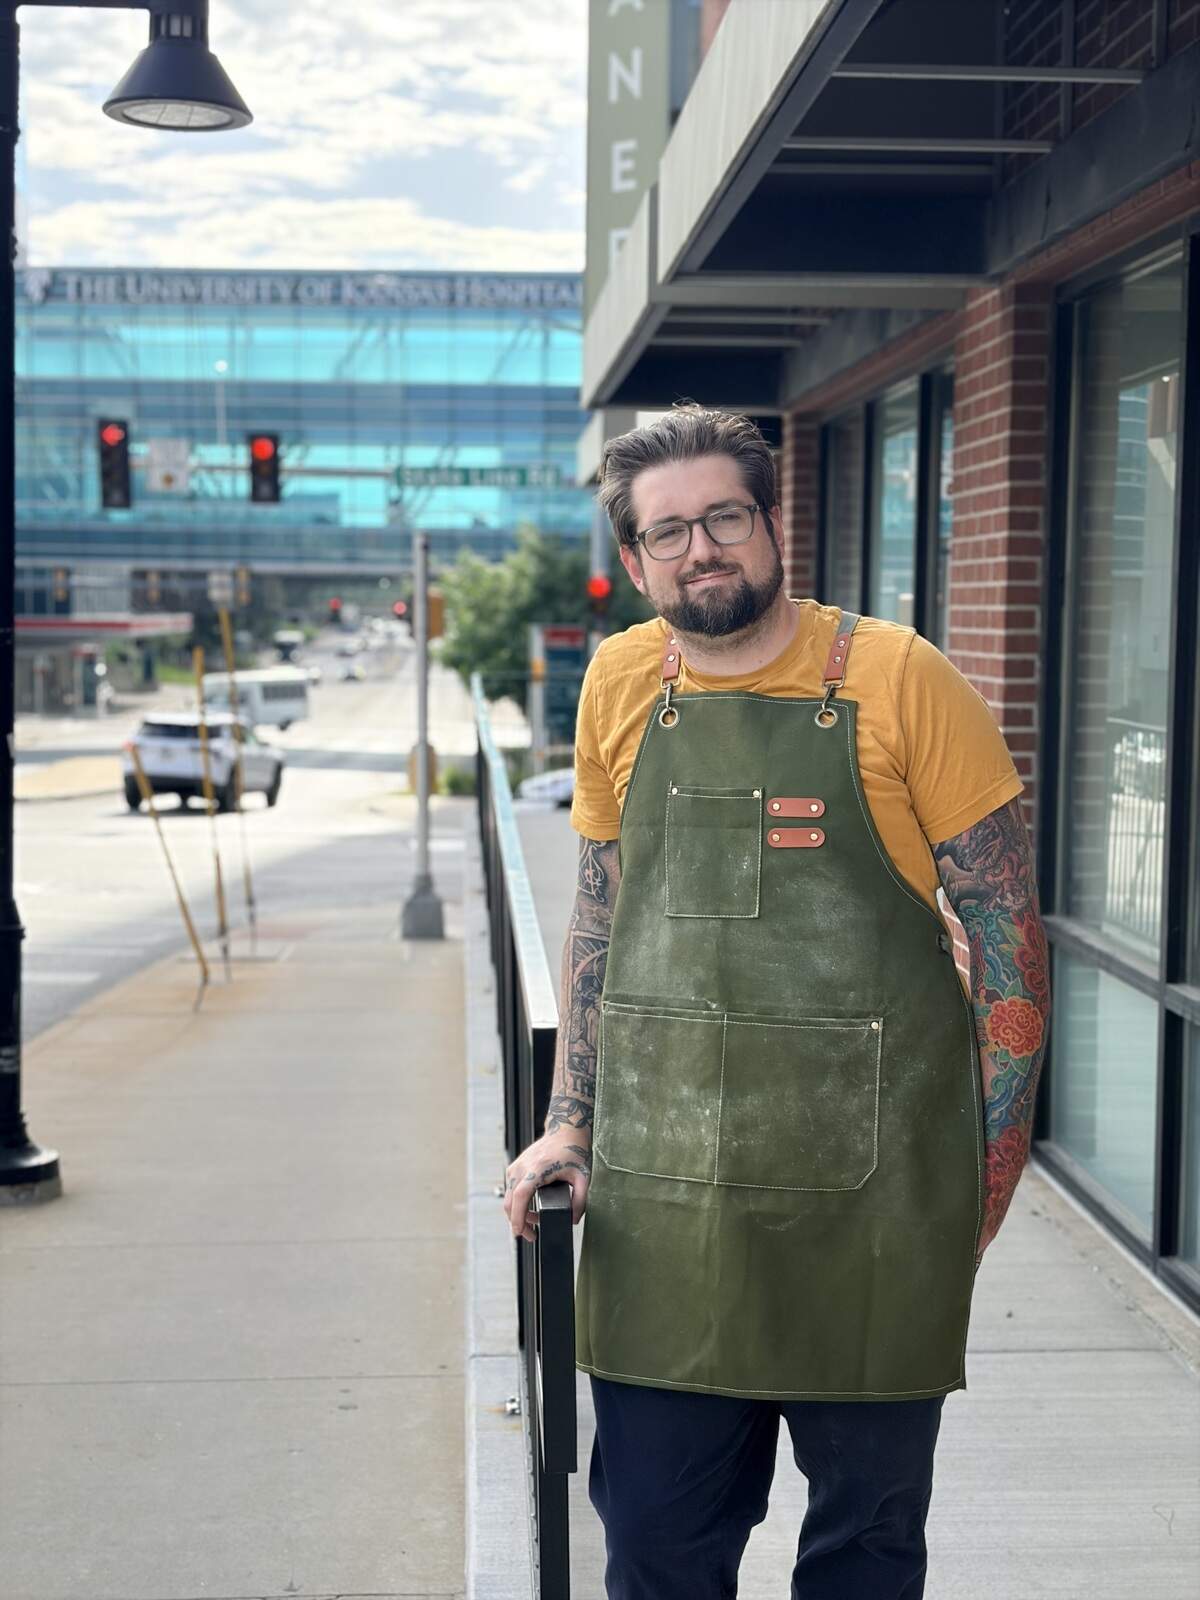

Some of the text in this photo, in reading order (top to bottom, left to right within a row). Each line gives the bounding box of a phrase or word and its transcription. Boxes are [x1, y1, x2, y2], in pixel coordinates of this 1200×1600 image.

[64, 272, 116, 304] THE
[403, 465, 557, 486] State Line Rd
